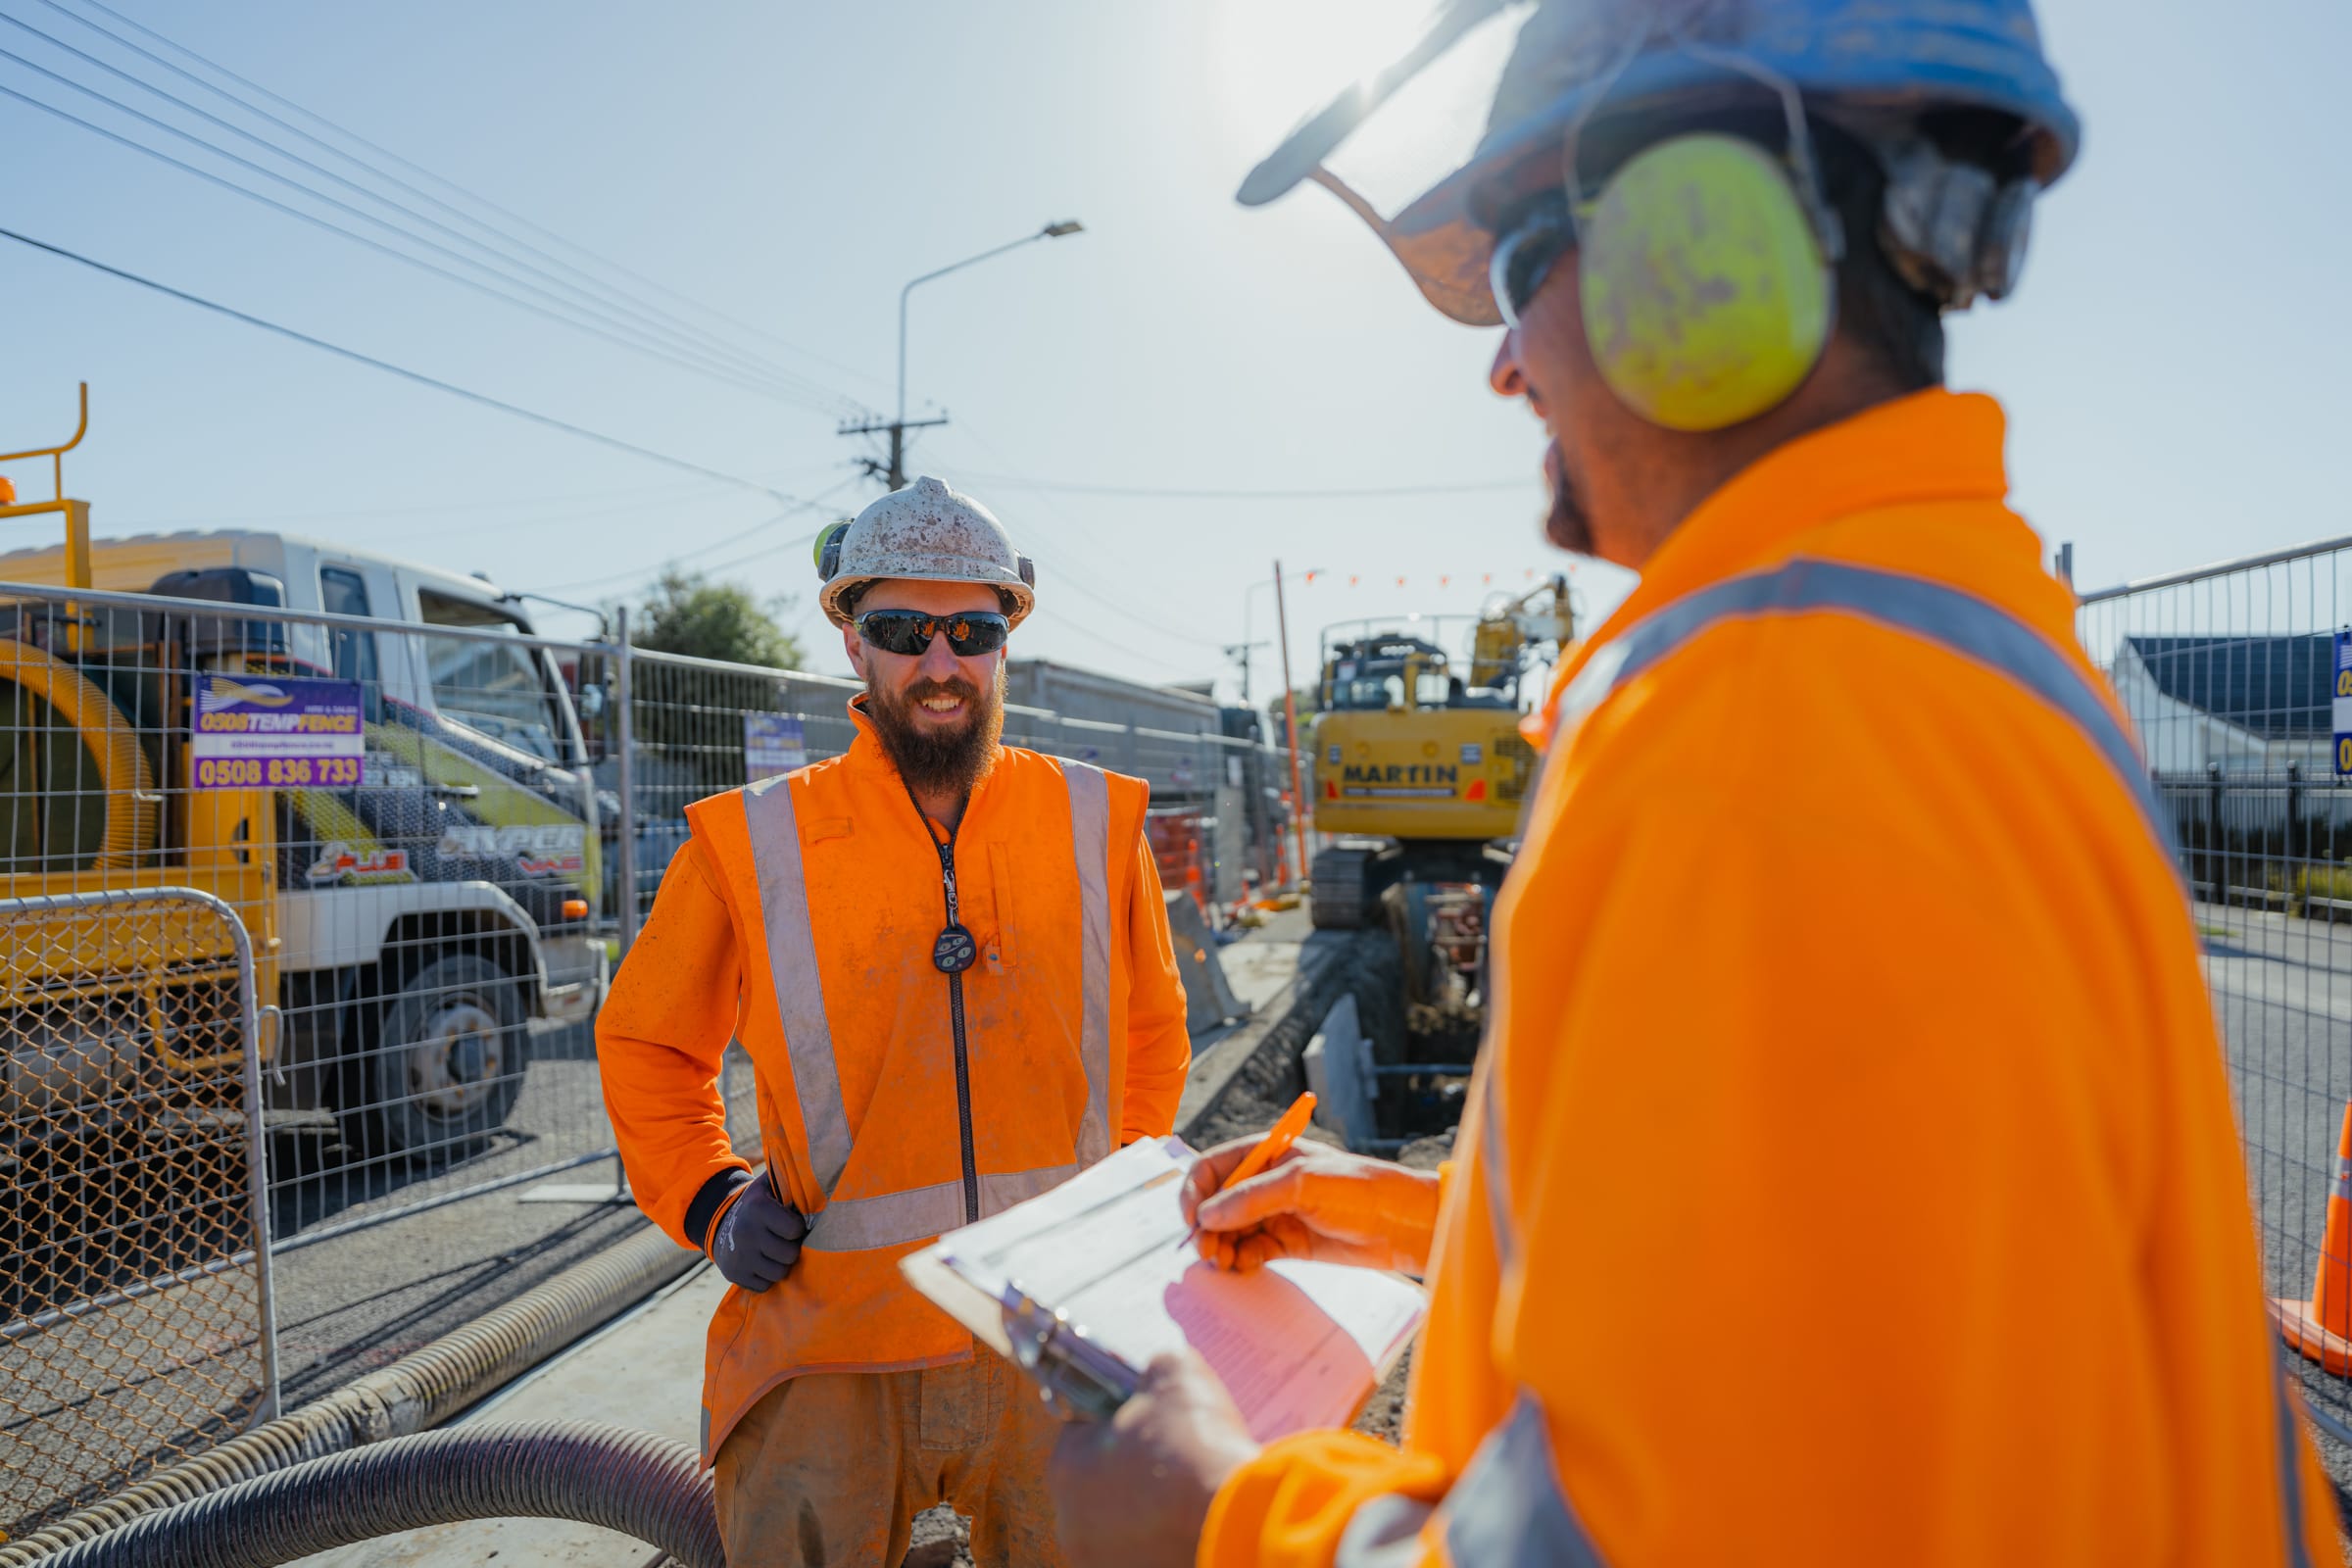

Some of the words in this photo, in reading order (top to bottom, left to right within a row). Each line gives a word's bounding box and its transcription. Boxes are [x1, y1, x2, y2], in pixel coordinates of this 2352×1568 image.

[200, 712, 357, 733] 0508TEMPFENCE
[199, 759, 262, 785] 0508
[268, 759, 312, 784] 836
[318, 758, 358, 783] 733
[1344, 763, 1457, 783] MARTIN
